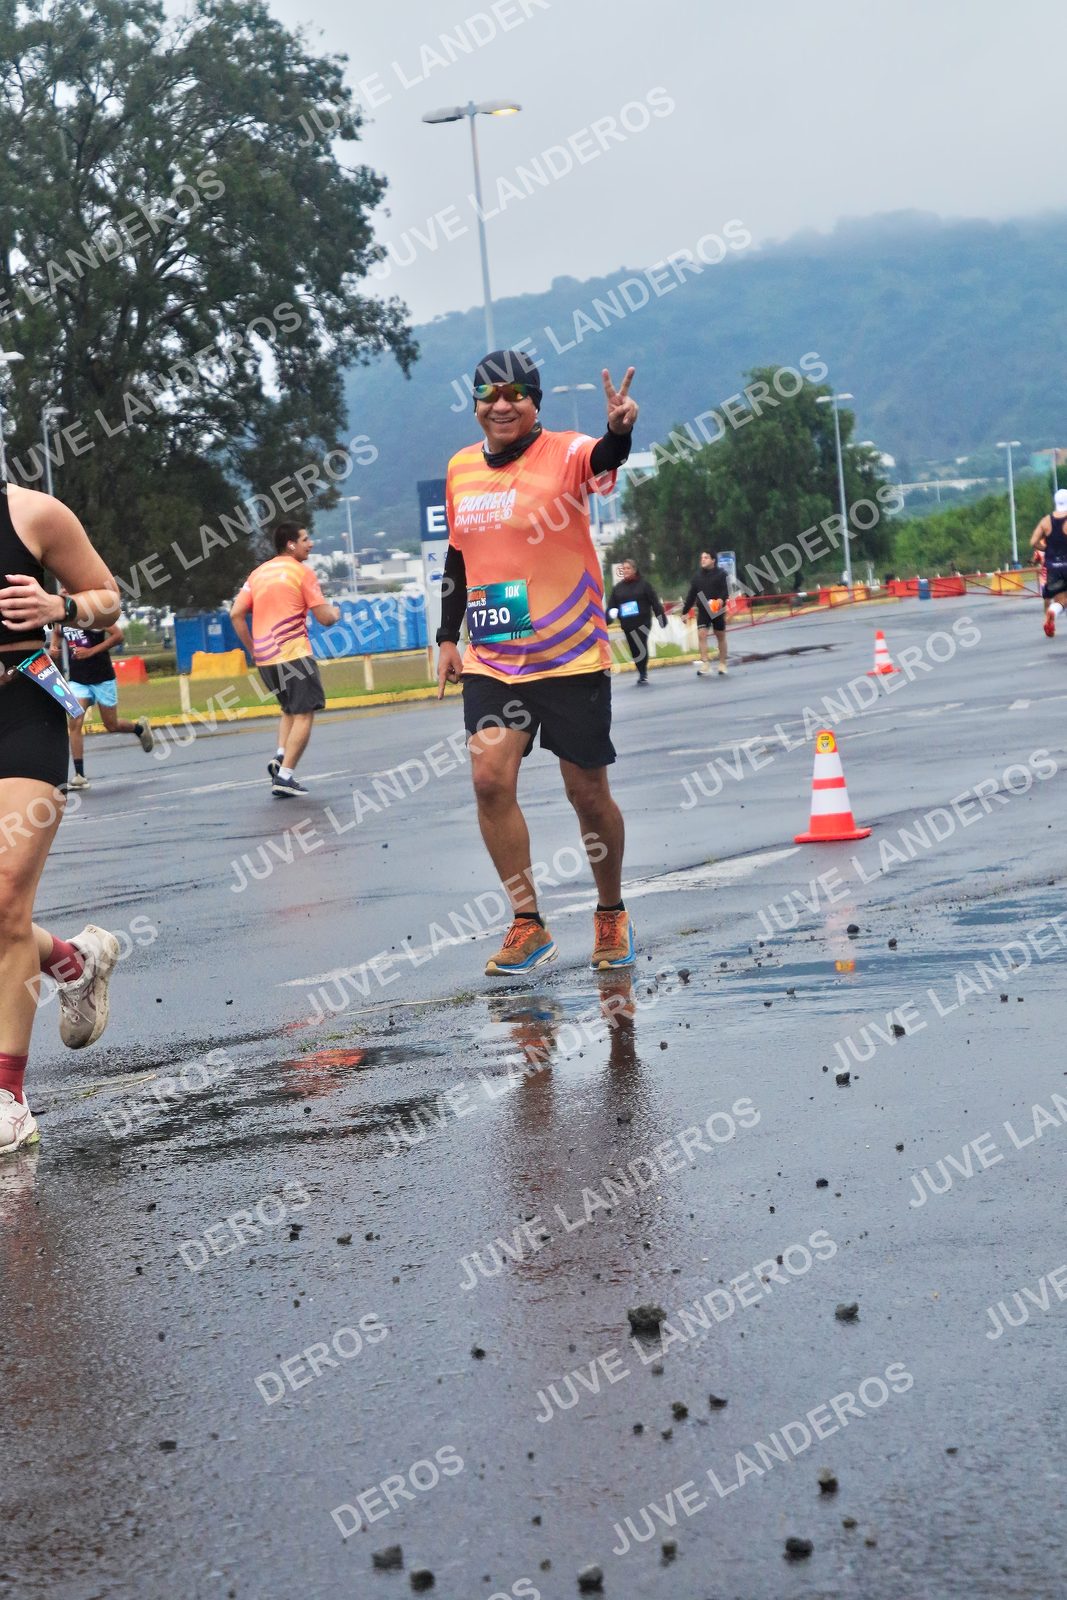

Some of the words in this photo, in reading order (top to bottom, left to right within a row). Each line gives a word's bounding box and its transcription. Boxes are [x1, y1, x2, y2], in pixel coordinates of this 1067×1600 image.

[426, 505, 447, 532] E
[504, 585, 520, 599] 10K
[472, 606, 511, 628] 1730
[63, 630, 87, 641] THE
